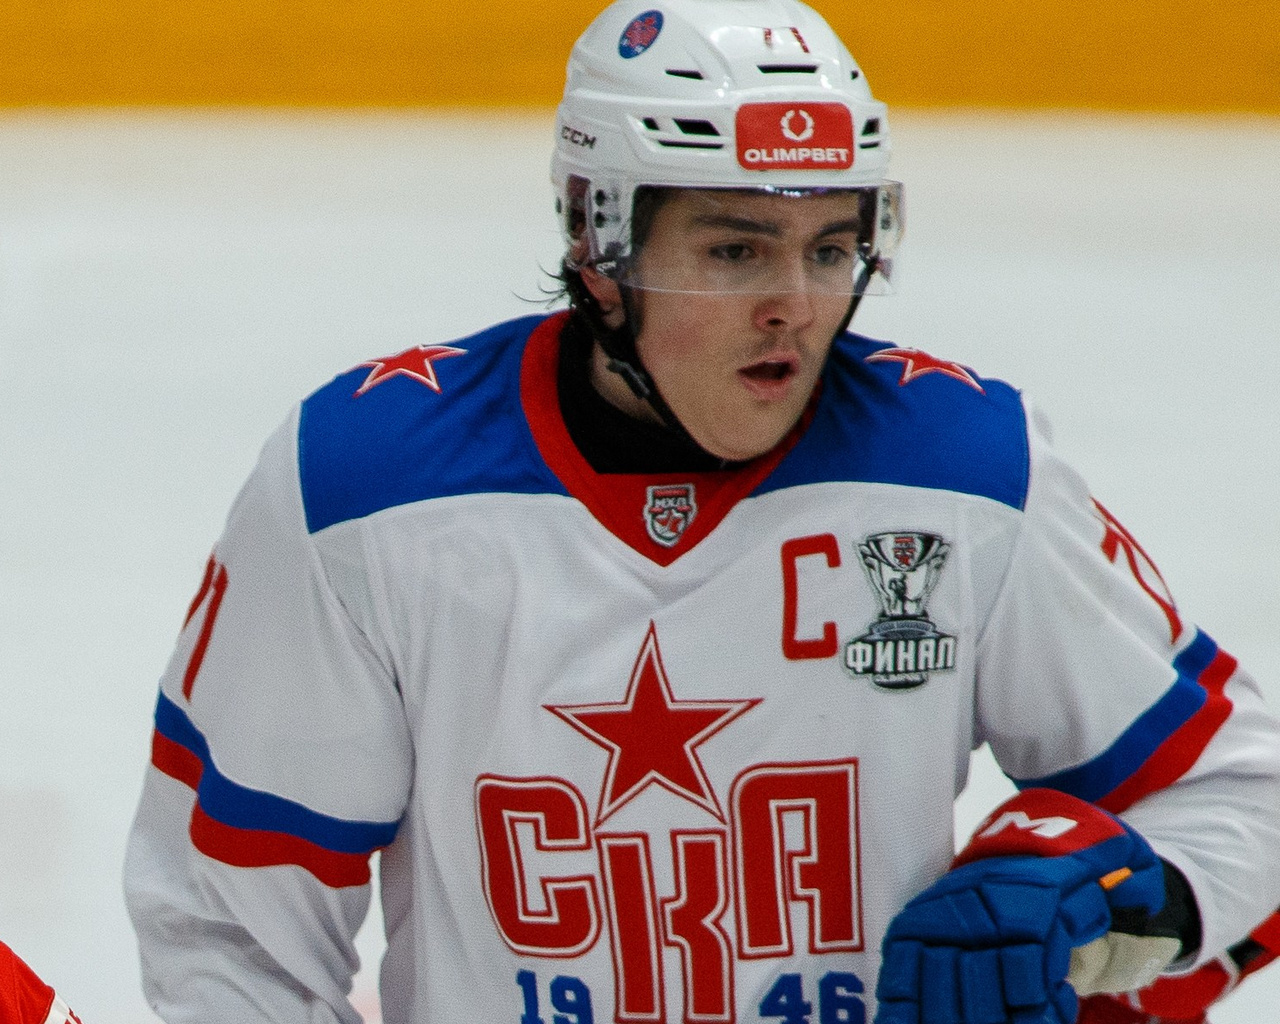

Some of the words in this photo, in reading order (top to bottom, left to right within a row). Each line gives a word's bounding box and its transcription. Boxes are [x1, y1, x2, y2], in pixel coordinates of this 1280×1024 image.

[562, 126, 597, 148] CCM
[744, 147, 849, 163] OLIMPBET
[846, 637, 956, 674] ФИНАЛ
